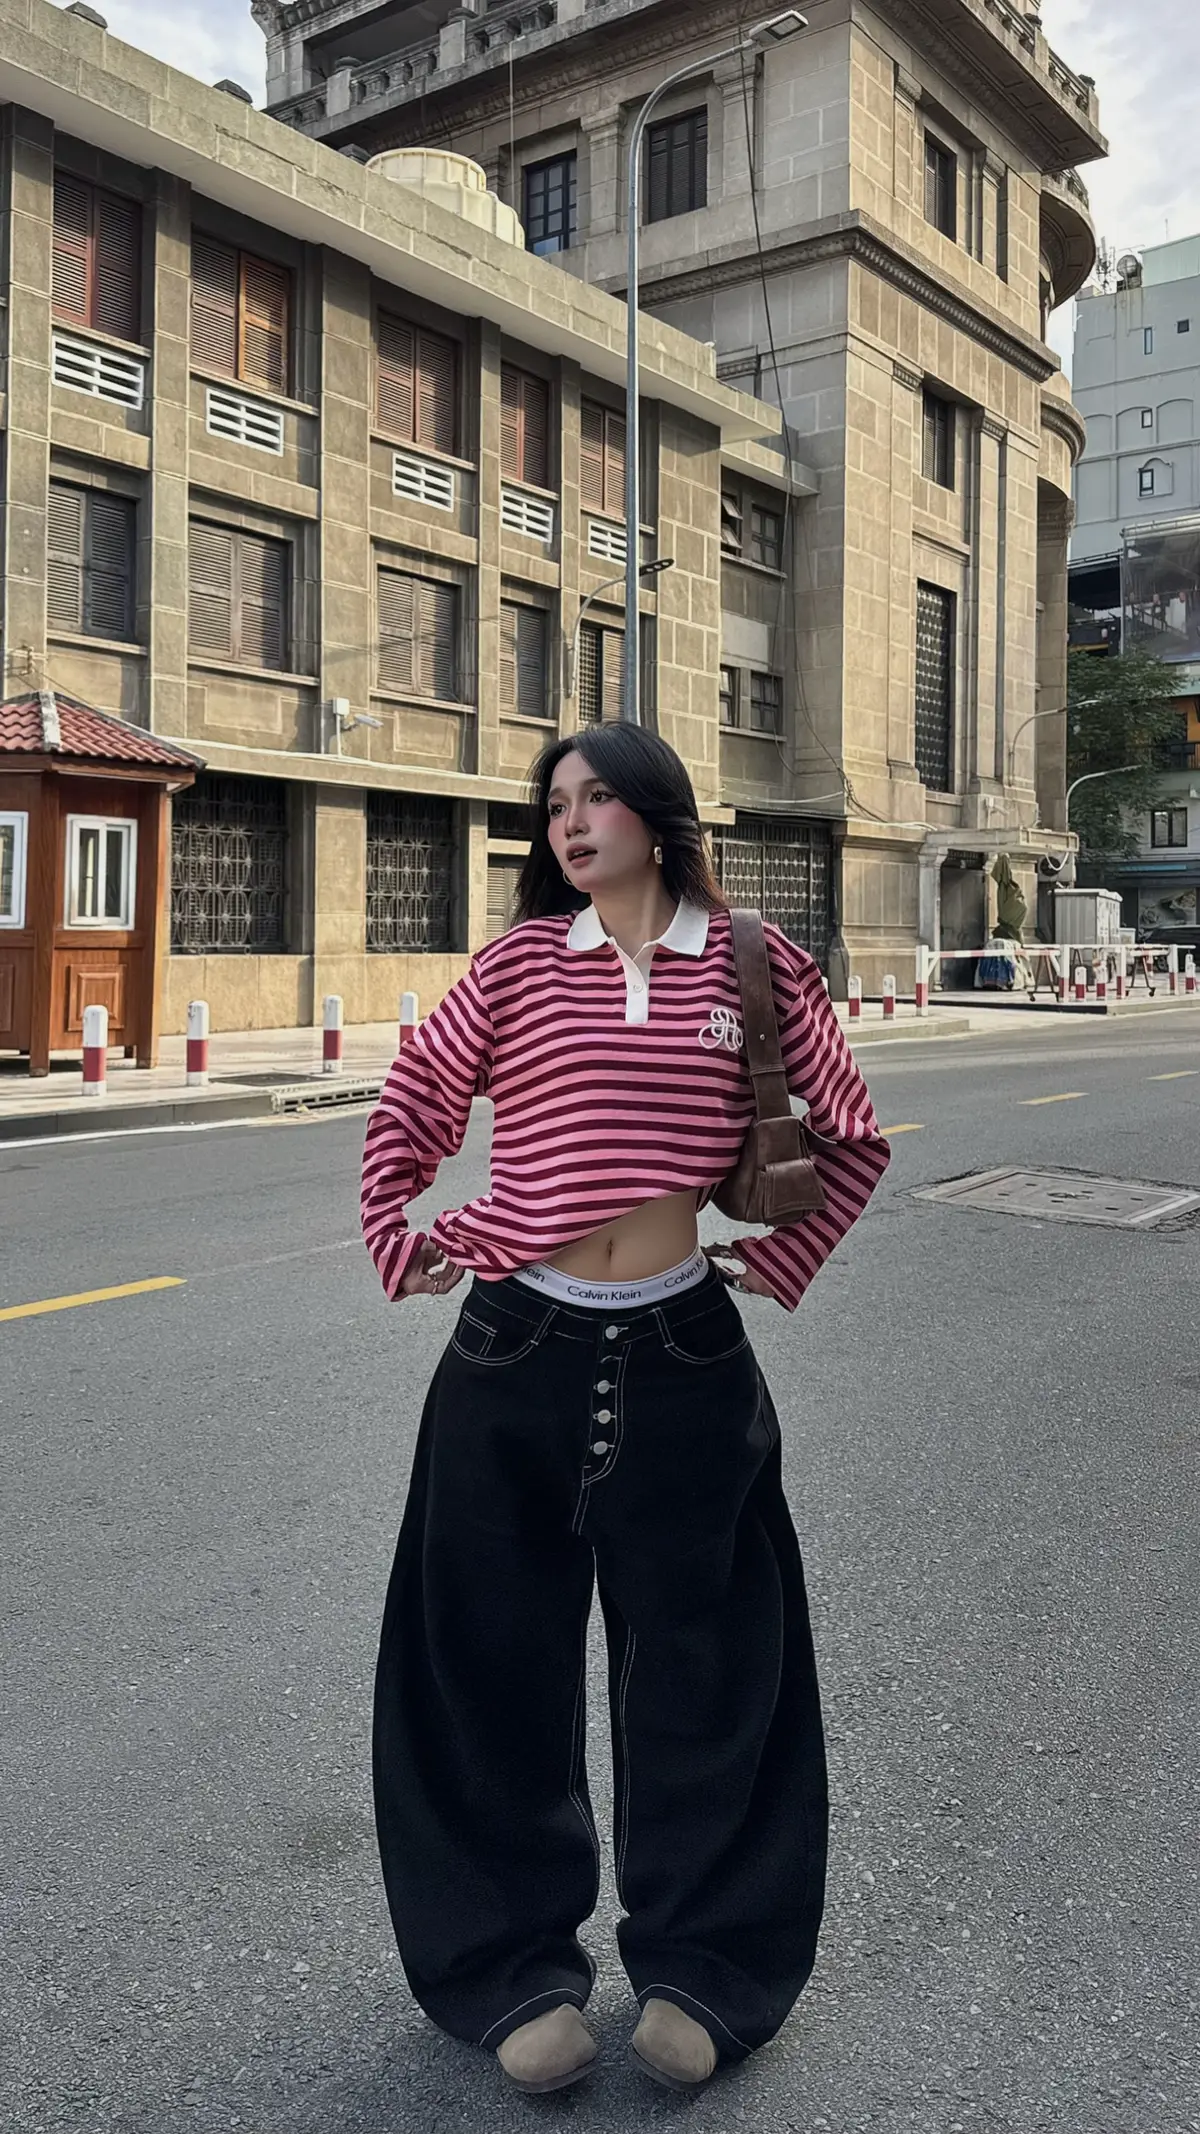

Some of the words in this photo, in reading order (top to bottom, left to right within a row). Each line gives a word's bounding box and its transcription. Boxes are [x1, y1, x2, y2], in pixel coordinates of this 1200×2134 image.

[664, 1268, 698, 1288] Calvin
[567, 1285, 608, 1301] Calvin
[611, 1289, 642, 1301] Klein
